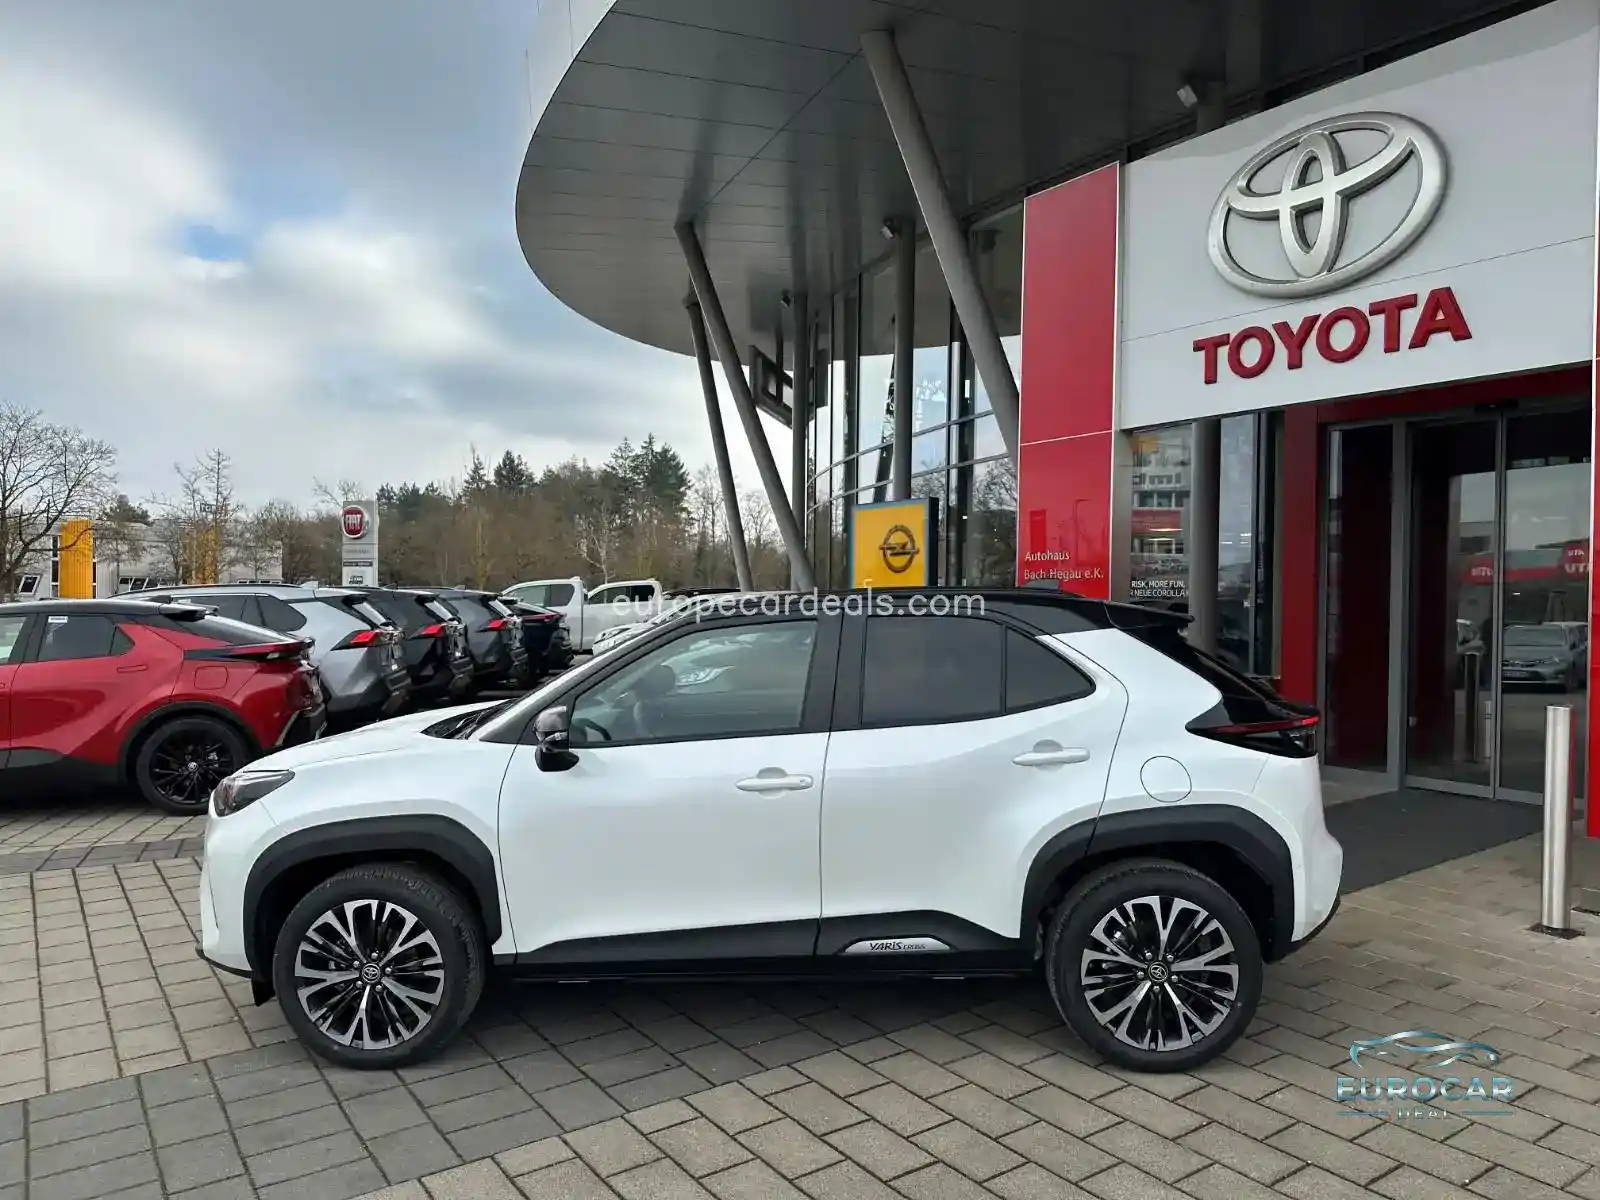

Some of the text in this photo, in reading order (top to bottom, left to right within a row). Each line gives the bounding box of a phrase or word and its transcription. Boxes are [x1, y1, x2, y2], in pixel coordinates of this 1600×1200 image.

[1192, 286, 1472, 385] TOYOTA
[1024, 549, 1070, 561] Autohaus
[1084, 567, 1104, 579] e.K.
[1148, 580, 1169, 588] MORE
[1169, 580, 1186, 588] FUN.
[1134, 589, 1152, 597] NEUE
[1152, 589, 1185, 597] COROLLA
